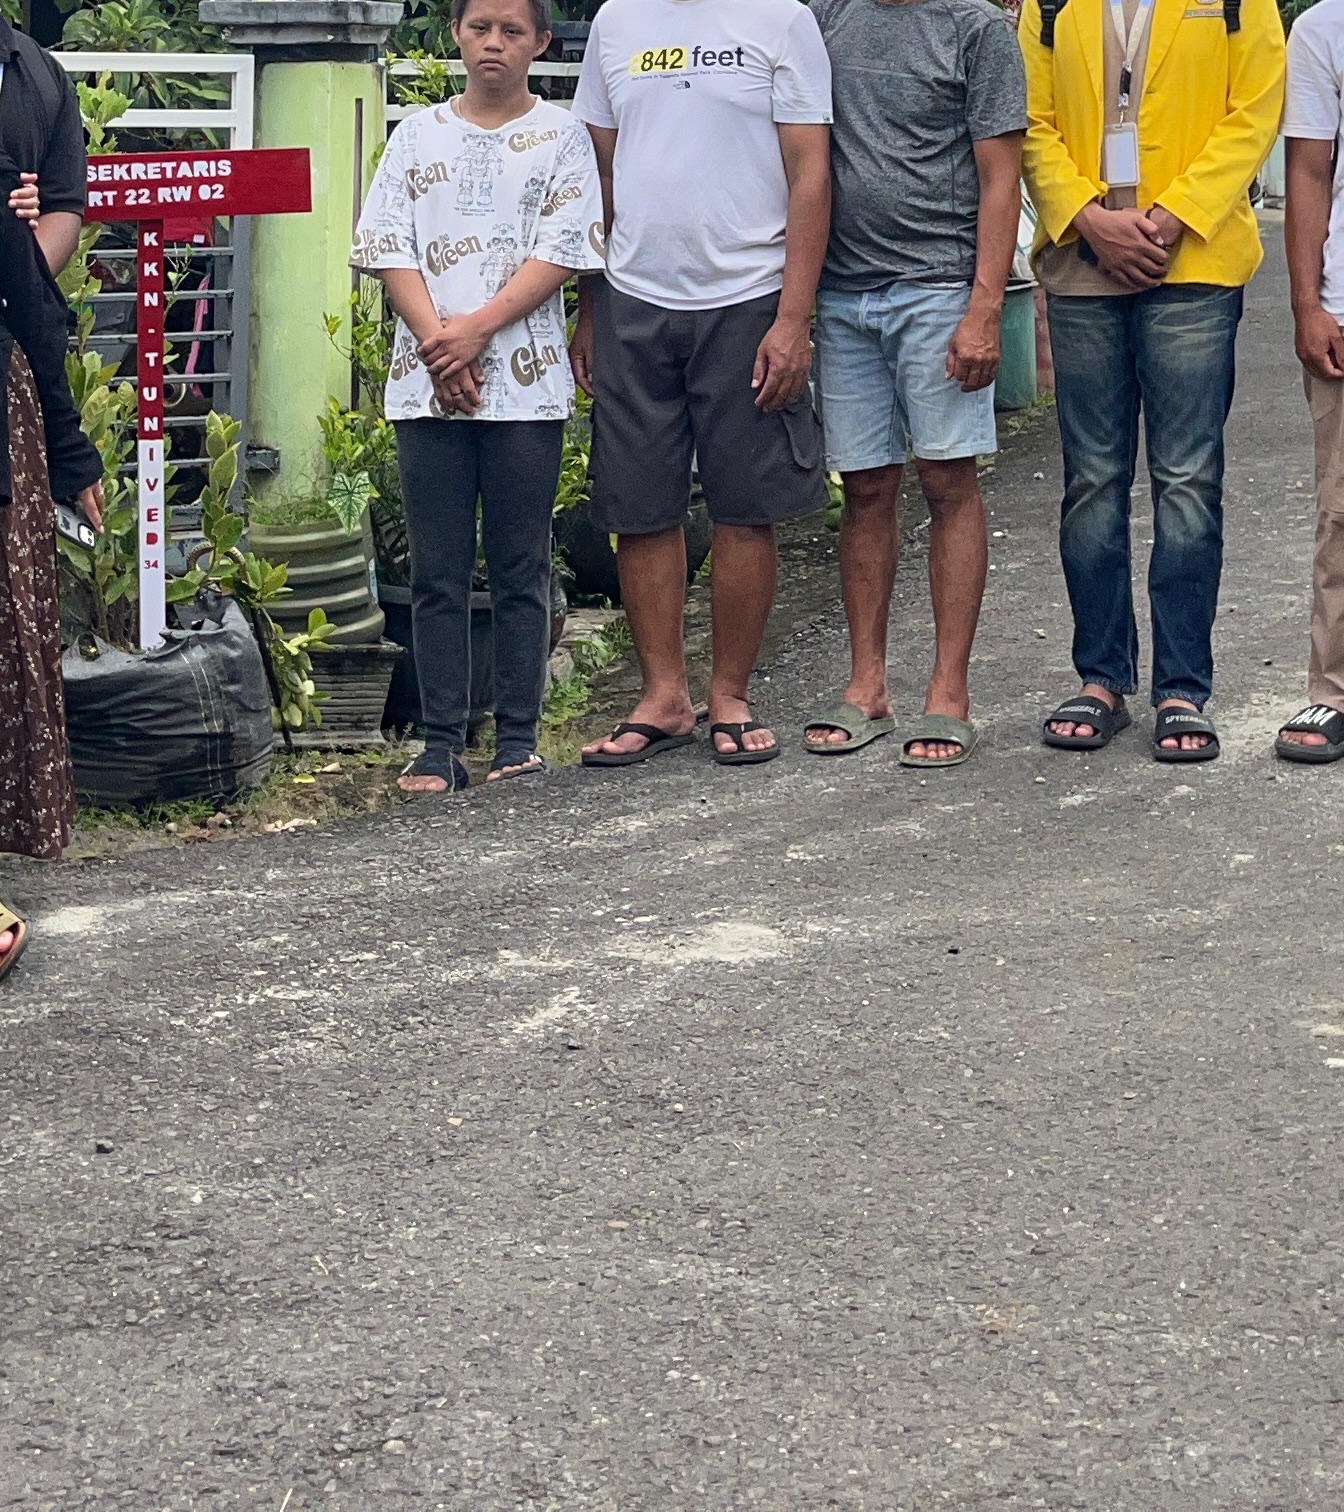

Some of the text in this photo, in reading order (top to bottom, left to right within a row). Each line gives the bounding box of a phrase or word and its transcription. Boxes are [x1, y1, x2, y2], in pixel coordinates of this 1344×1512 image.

[692, 45, 744, 67] feet
[508, 130, 558, 153] Green
[86, 160, 232, 183] SEKRETARIS
[88, 184, 225, 207] RT 22 RW 02
[425, 235, 484, 277] Green
[144, 560, 159, 570] 34
